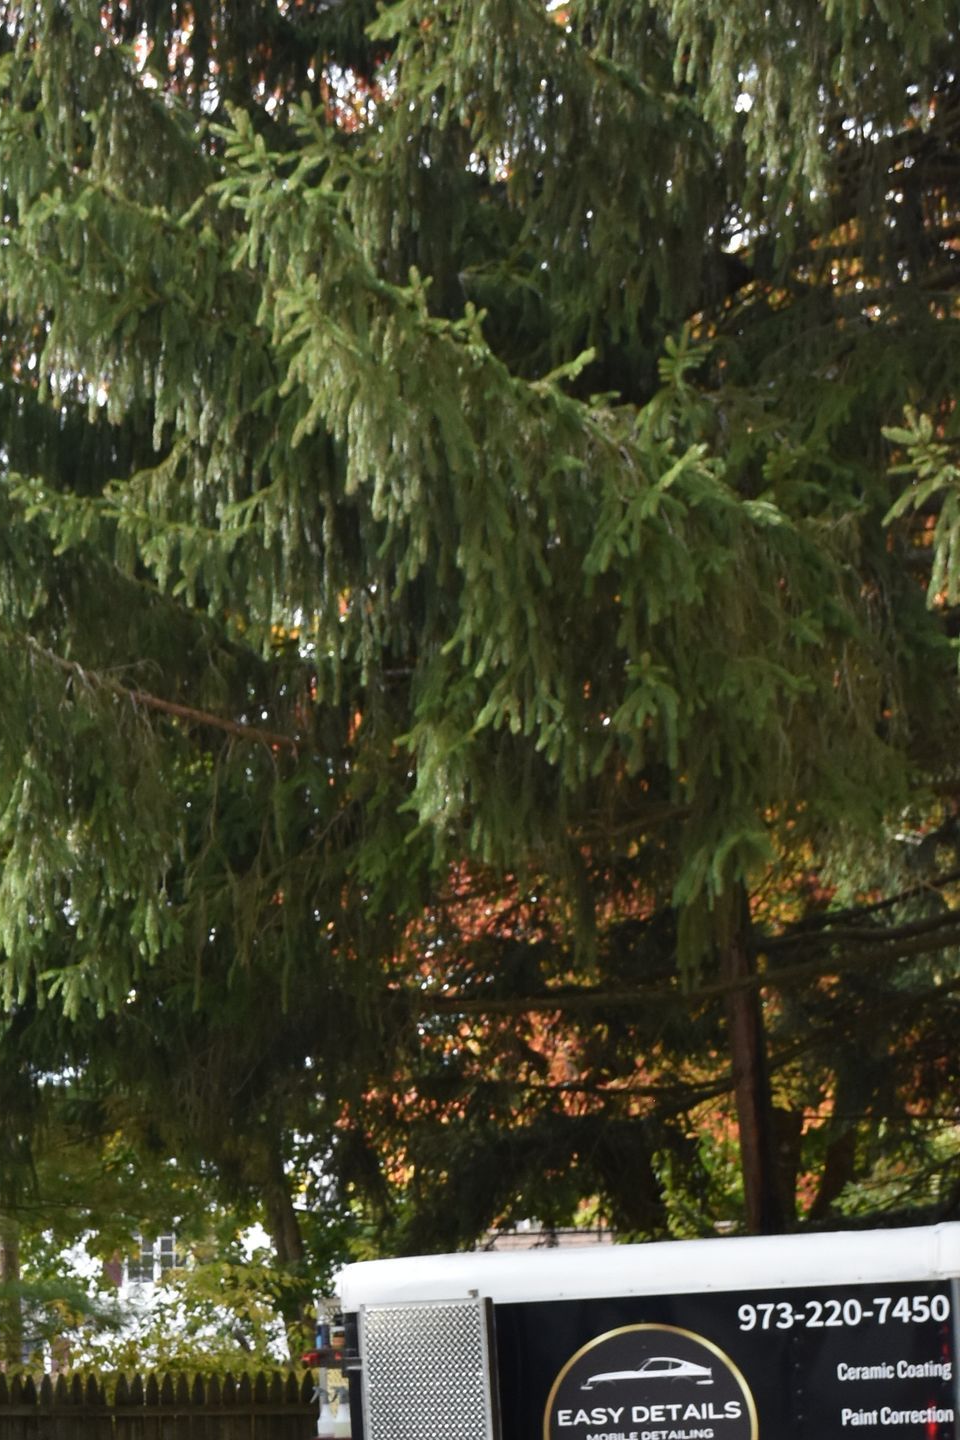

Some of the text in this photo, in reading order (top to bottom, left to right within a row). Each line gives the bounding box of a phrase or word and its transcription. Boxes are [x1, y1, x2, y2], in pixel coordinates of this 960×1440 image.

[738, 1294, 950, 1331] 973-220-7450
[837, 1360, 952, 1381] Ceramic Coating
[557, 1401, 742, 1427] EASY DETAILS
[841, 1406, 954, 1427] Paint Correction
[641, 1428, 714, 1440] DETAILING
